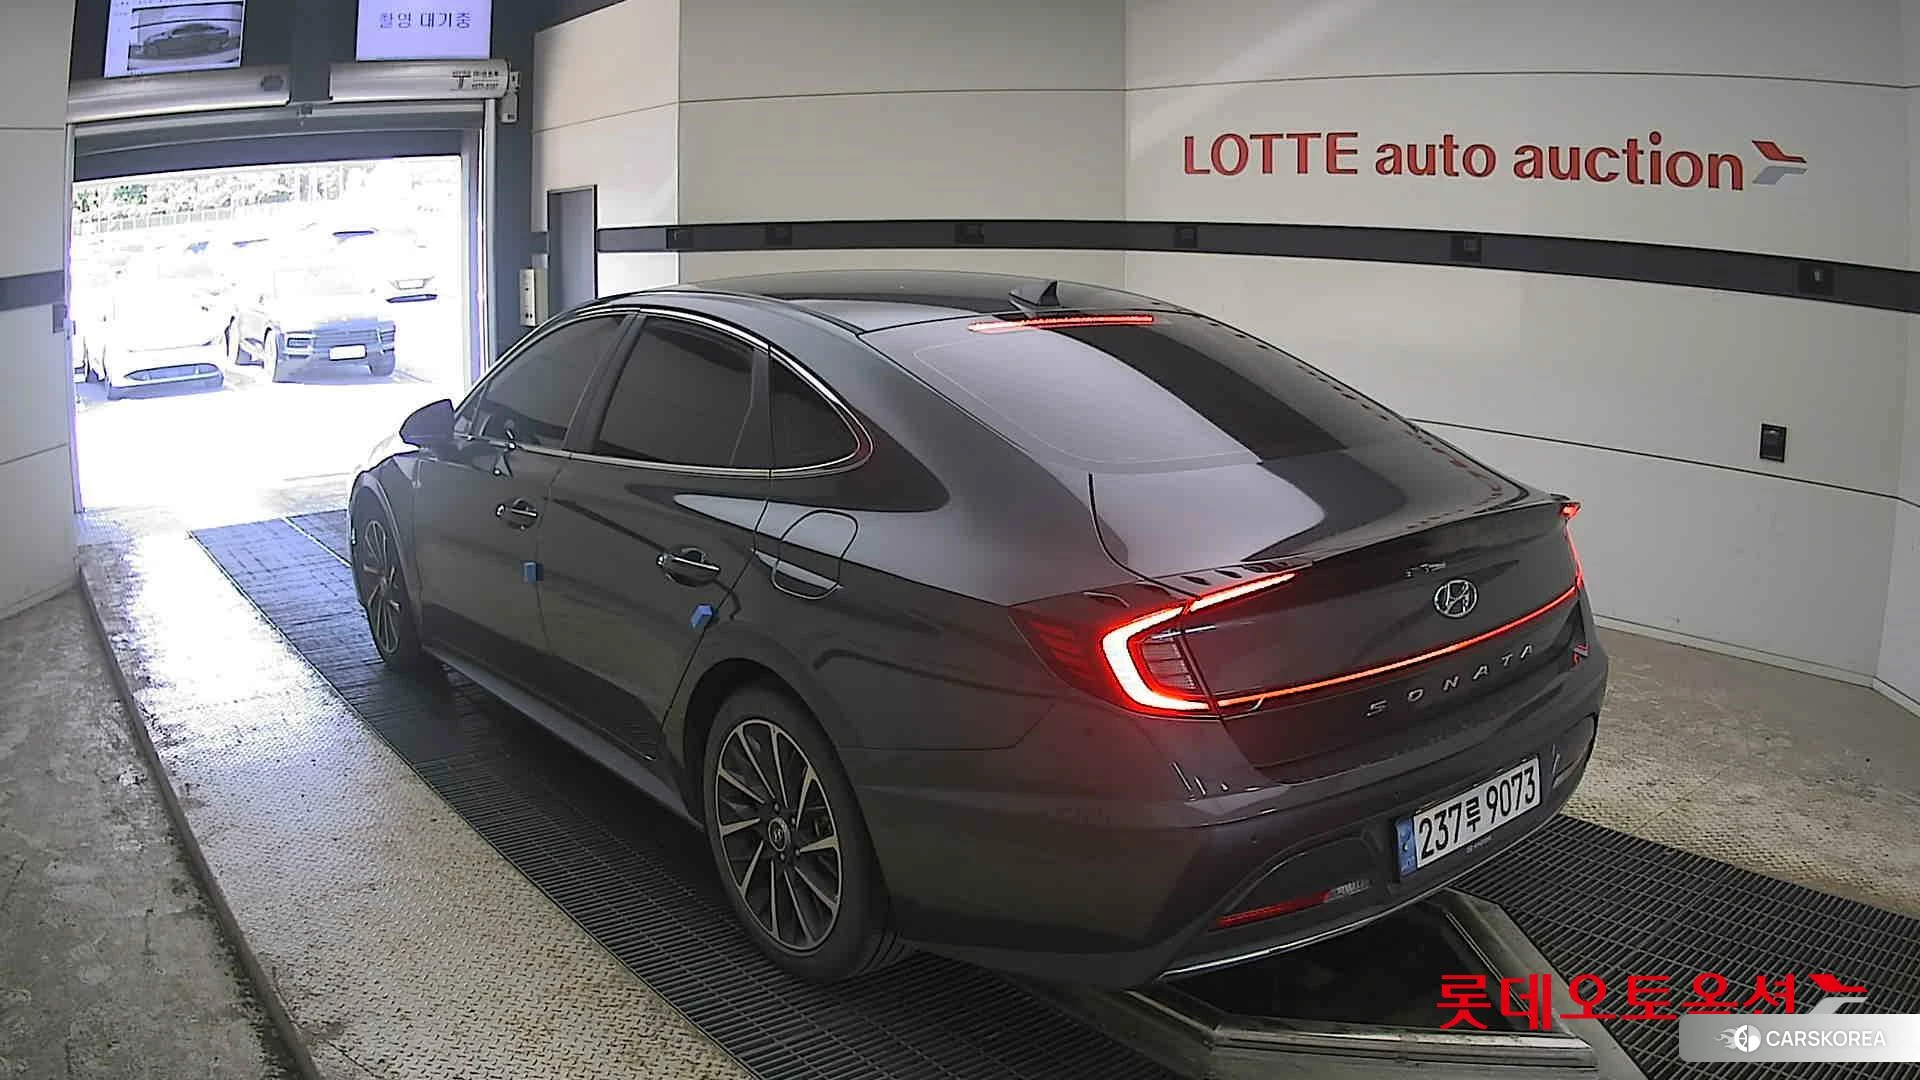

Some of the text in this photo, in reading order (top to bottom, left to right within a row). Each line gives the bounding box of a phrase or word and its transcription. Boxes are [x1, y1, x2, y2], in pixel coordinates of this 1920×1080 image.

[420, 12, 473, 29] 대기중
[1184, 130, 1744, 191] LOTTE auto auction
[1366, 643, 1534, 717] SONATA
[1418, 765, 1536, 860] 237루 9073
